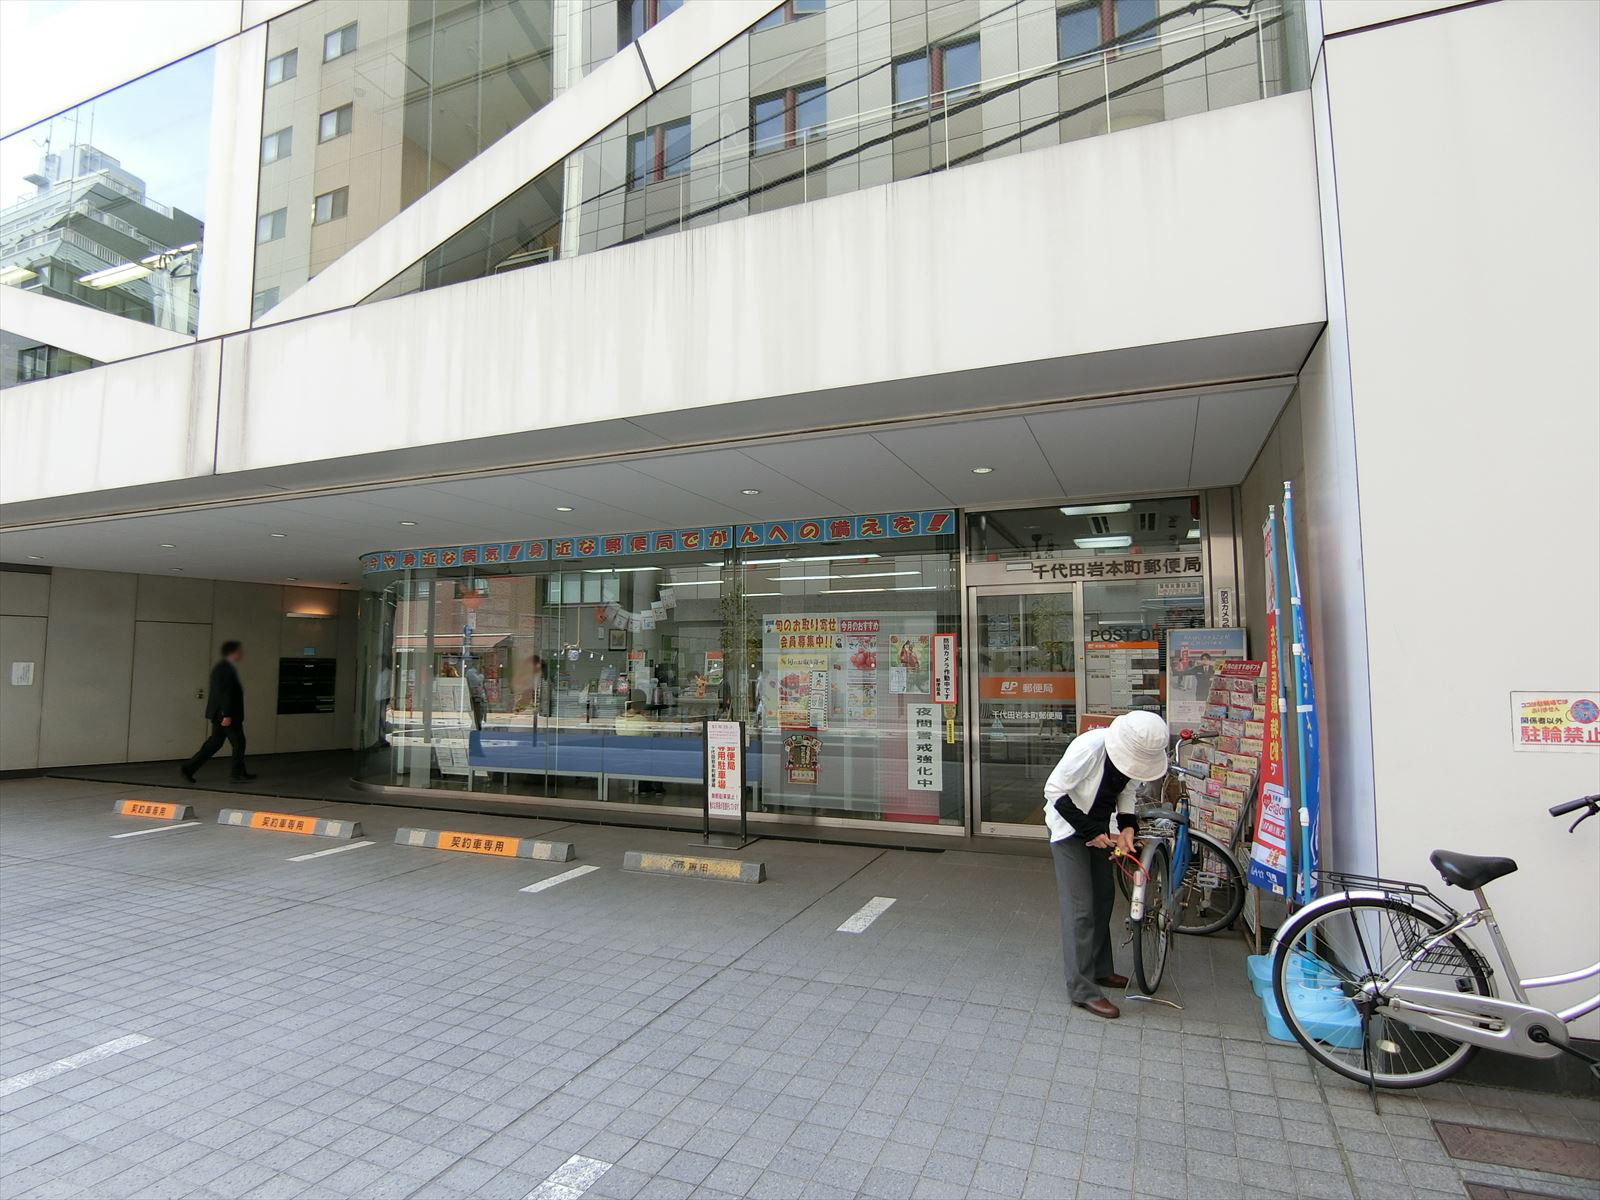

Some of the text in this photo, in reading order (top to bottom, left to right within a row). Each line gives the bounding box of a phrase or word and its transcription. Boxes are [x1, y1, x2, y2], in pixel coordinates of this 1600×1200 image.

[1033, 557, 1201, 579] 千代田岩本町郵便局
[775, 618, 836, 632] 旬のお取り寄せ
[841, 621, 879, 631] 今月のおすすめ
[780, 635, 833, 649] 会員募集中!!
[1090, 629, 1132, 641] POST
[1023, 683, 1053, 693] 郵便局
[992, 710, 1063, 720] 千代田岩本町郵便局
[1521, 726, 1600, 743] 駐輪禁止
[916, 707, 933, 787] 夜間警戒強化中
[131, 804, 167, 816] 契約車専用
[261, 817, 304, 831] 契約車専用
[450, 836, 505, 852] 契約車専用
